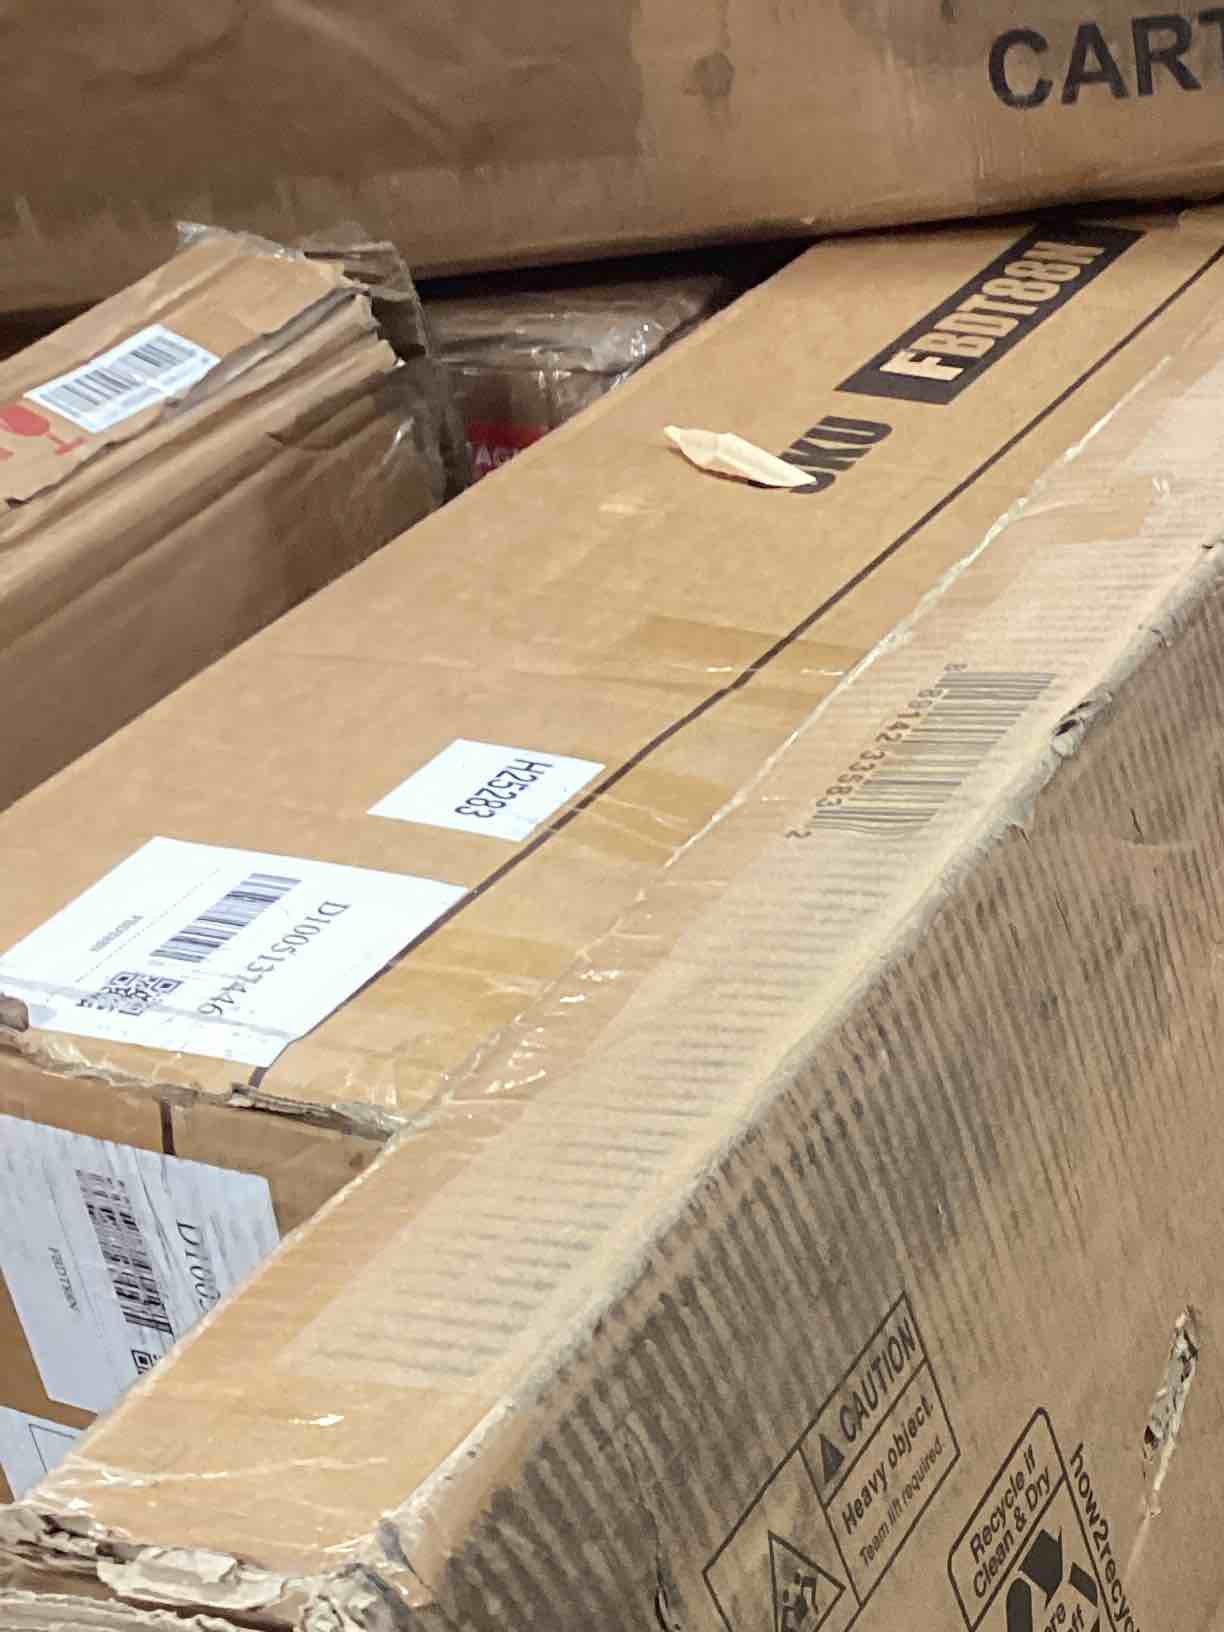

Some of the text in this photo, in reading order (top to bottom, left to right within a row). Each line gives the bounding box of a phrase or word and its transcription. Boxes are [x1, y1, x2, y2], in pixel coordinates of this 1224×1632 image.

[838, 1318, 917, 1444] CAUTION
[841, 1395, 935, 1536] Heavy object.
[969, 1445, 1038, 1565] Recycle if
[858, 1523, 891, 1568] Team
[972, 1465, 1051, 1600] Clean & Dry
